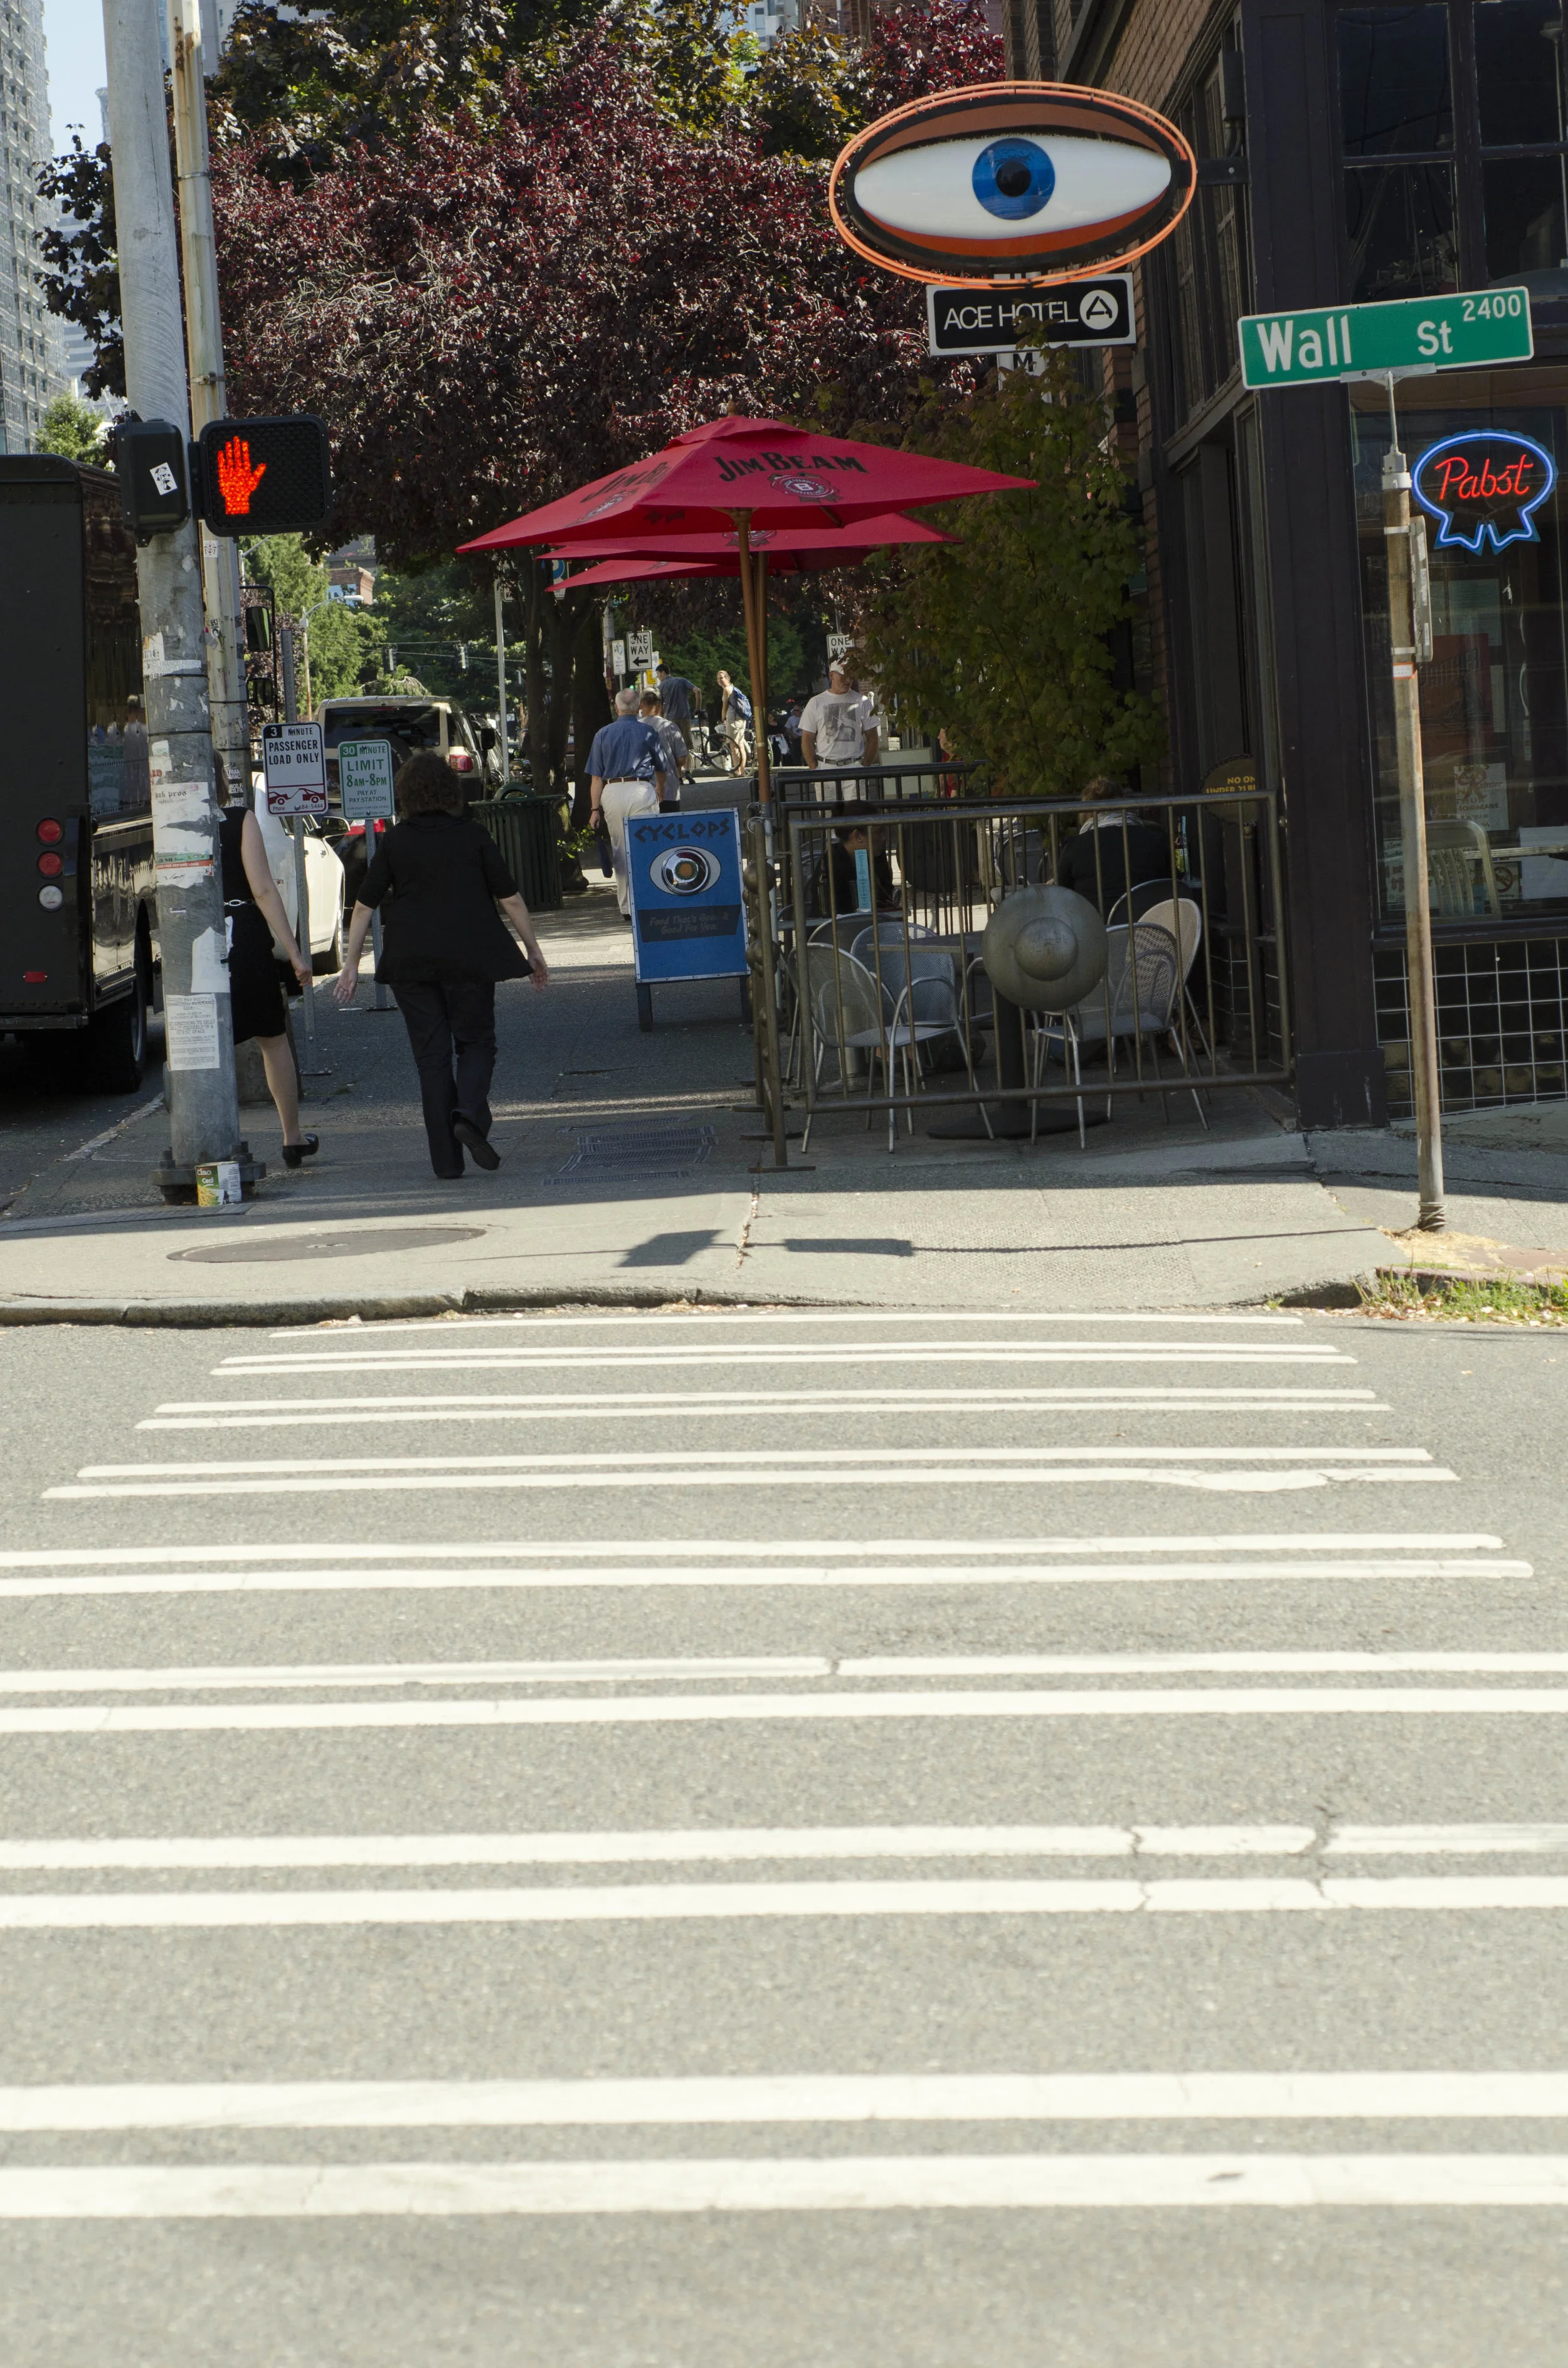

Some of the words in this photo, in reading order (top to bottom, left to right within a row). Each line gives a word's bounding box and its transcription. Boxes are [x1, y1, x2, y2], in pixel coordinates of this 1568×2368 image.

[1461, 294, 1522, 322] 2400
[943, 305, 993, 331] ACE
[999, 300, 1079, 327] HOTEL
[1256, 314, 1352, 373] Wall
[1417, 319, 1454, 356] St
[714, 456, 768, 482] JIM
[760, 452, 870, 474] BEAM
[1434, 454, 1534, 501] Pabst
[630, 635, 648, 645] ONE
[831, 637, 850, 646] ONE
[630, 645, 649, 655] WAY
[831, 647, 847, 656] WA
[270, 726, 277, 736] 3
[288, 727, 314, 736] MINUTE
[268, 740, 318, 752] PASSENGER
[343, 746, 356, 755] 30
[359, 746, 386, 755] MINUTE
[268, 755, 292, 765] LOAD
[296, 753, 319, 764] ONLY
[347, 759, 384, 772] LIMIT
[633, 817, 730, 843] CYCLOPS
[649, 916, 670, 926] Food
[662, 924, 682, 935] Good
[686, 923, 699, 933] For
